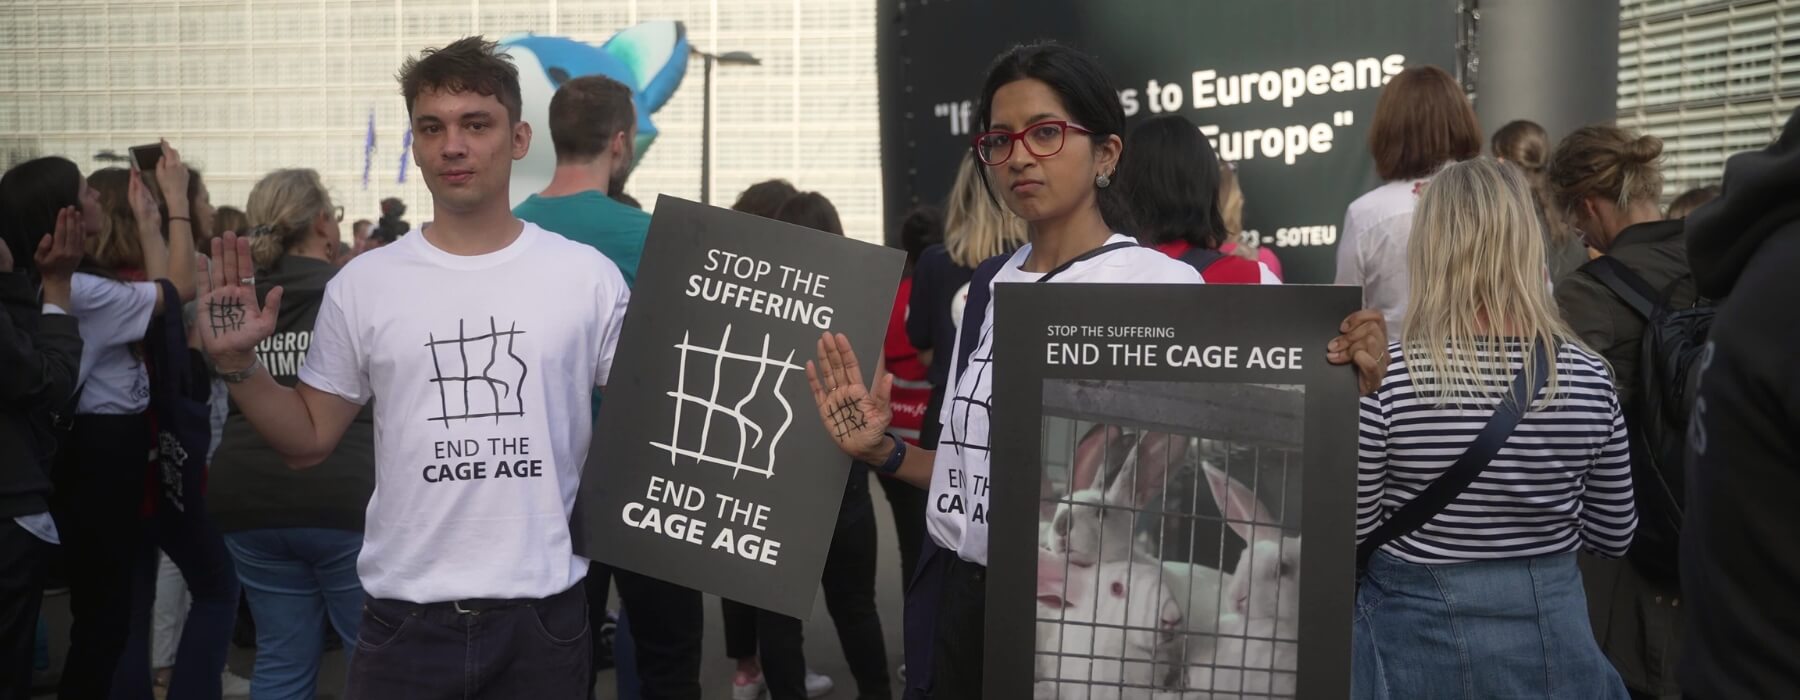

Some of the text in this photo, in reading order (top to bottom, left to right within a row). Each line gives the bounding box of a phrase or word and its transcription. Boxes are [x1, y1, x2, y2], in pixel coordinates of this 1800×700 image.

[1146, 78, 1184, 113] to
[1191, 53, 1406, 109] Europeans
[1275, 224, 1337, 248] SOTEU
[704, 249, 830, 298] STOP THE
[685, 274, 834, 329] SUFFERING
[254, 330, 314, 352] OGRO
[1047, 325, 1175, 338] STOP THE SUFFERING
[1046, 343, 1304, 370] END THE CAGE AGE
[434, 437, 530, 459] END THE
[422, 459, 543, 483] CAGE AGE
[646, 475, 772, 531] END THE
[621, 501, 782, 566] CAGE AGE
